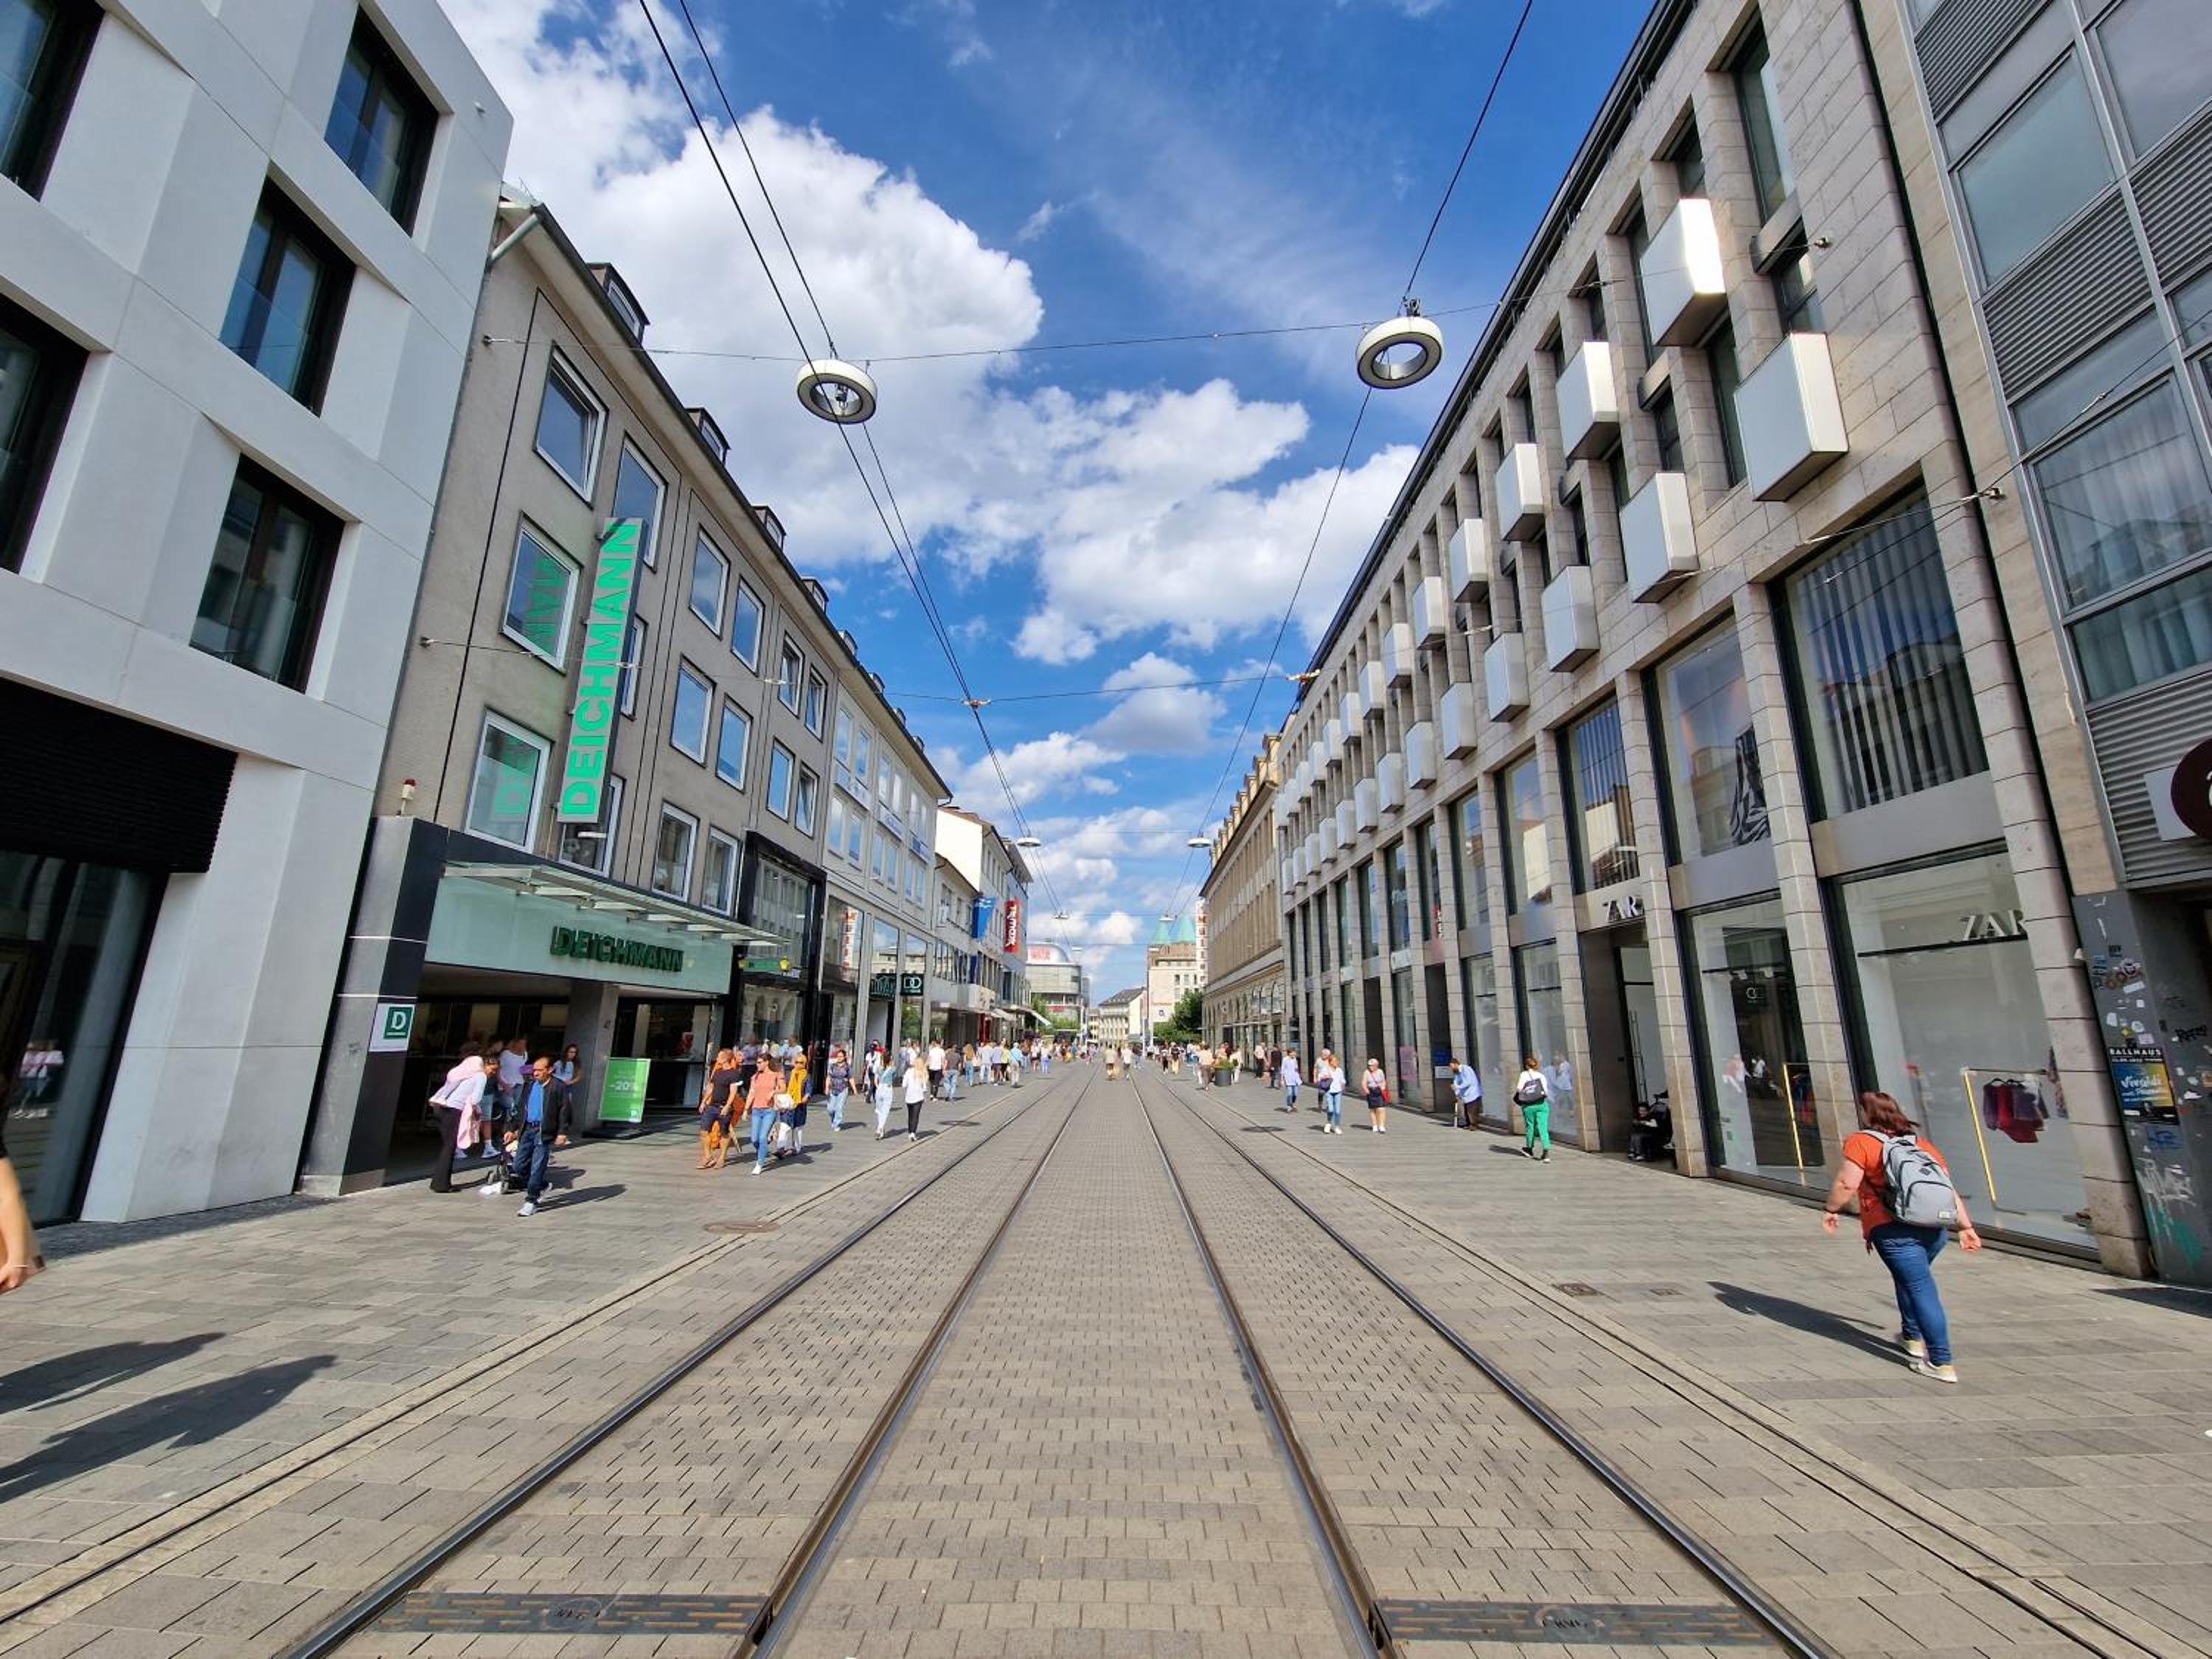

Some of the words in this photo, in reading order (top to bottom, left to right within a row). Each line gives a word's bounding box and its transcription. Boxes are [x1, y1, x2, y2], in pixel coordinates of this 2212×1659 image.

[562, 523, 639, 815] DEICHMANN
[550, 925, 684, 972] DEICHMANN
[391, 1011, 406, 1030] D
